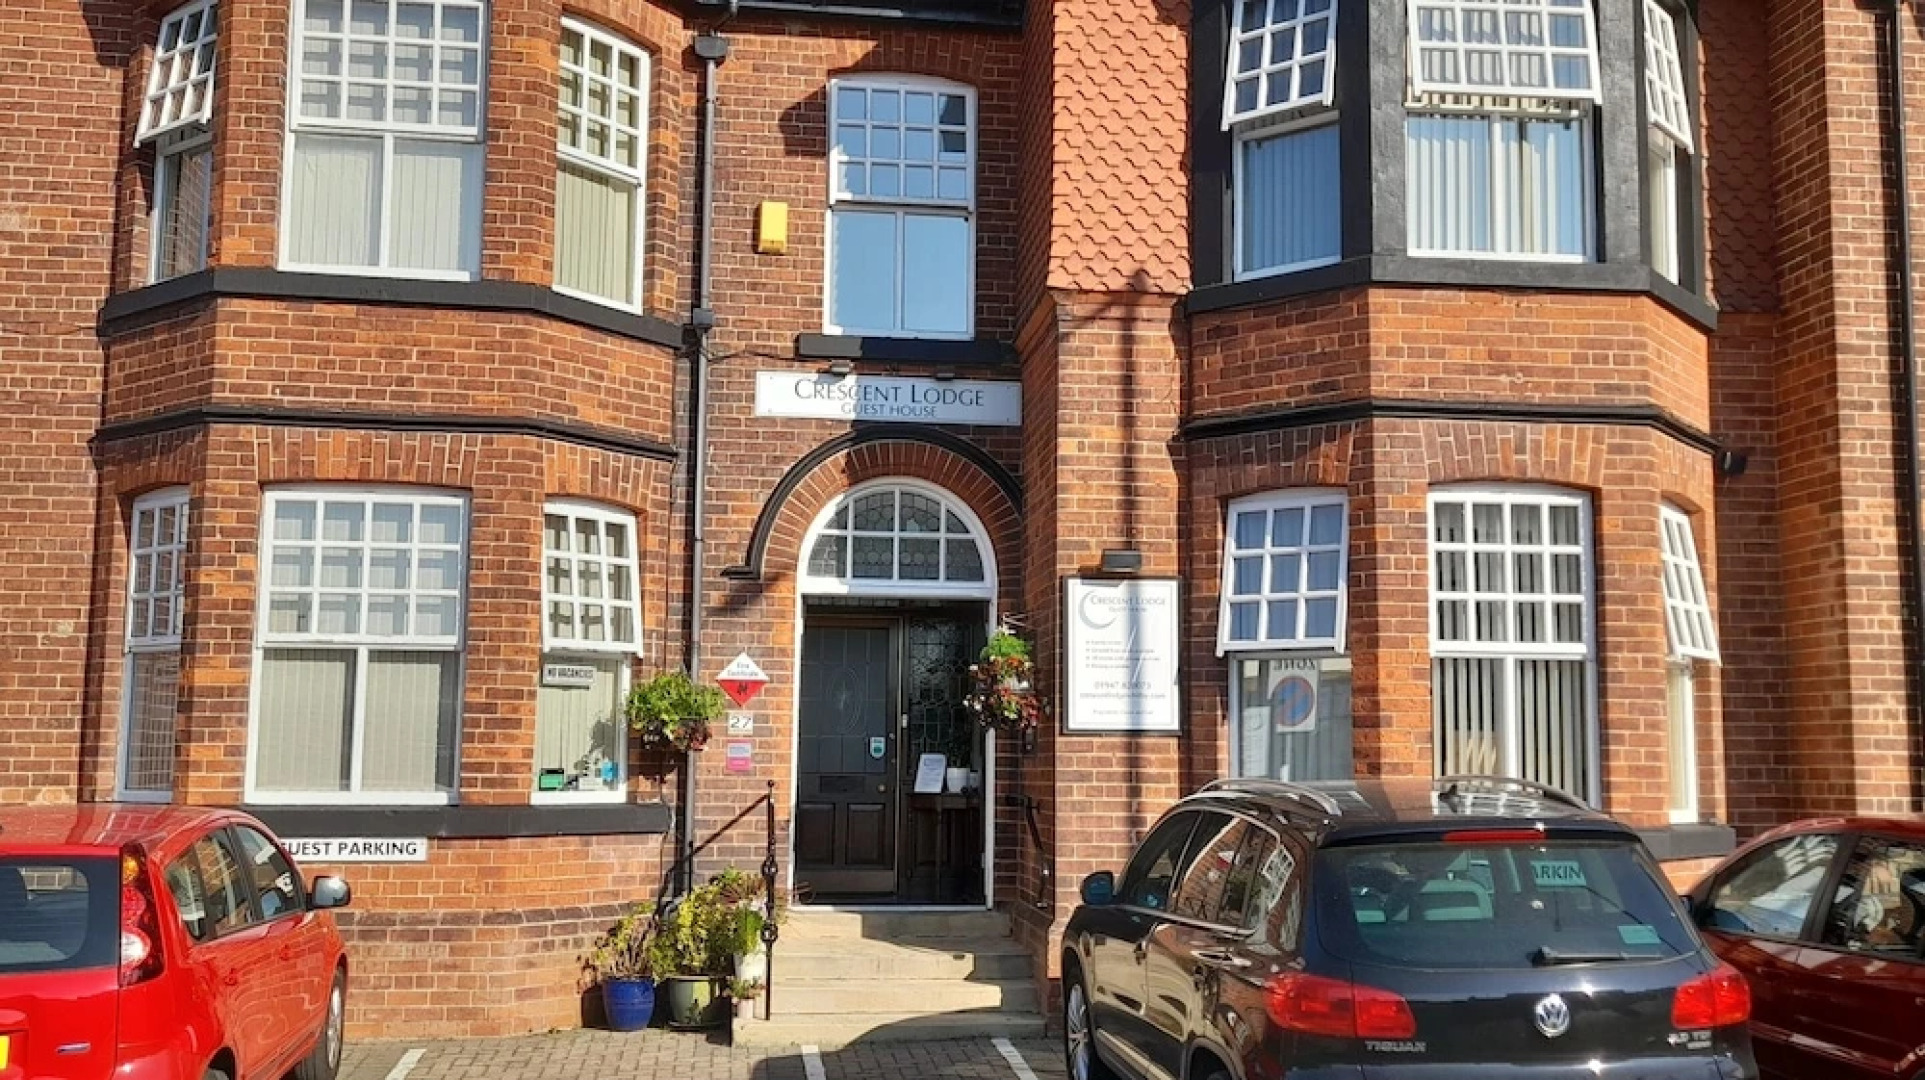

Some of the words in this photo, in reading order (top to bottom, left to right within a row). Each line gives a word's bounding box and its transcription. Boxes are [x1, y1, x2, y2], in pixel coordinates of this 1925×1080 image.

[794, 379, 902, 403] CRESCENT
[911, 384, 985, 407] LODGE
[841, 404, 886, 416] GUEST
[889, 405, 936, 417] HOUSE
[730, 715, 752, 729] 27
[338, 842, 417, 856] PARKING
